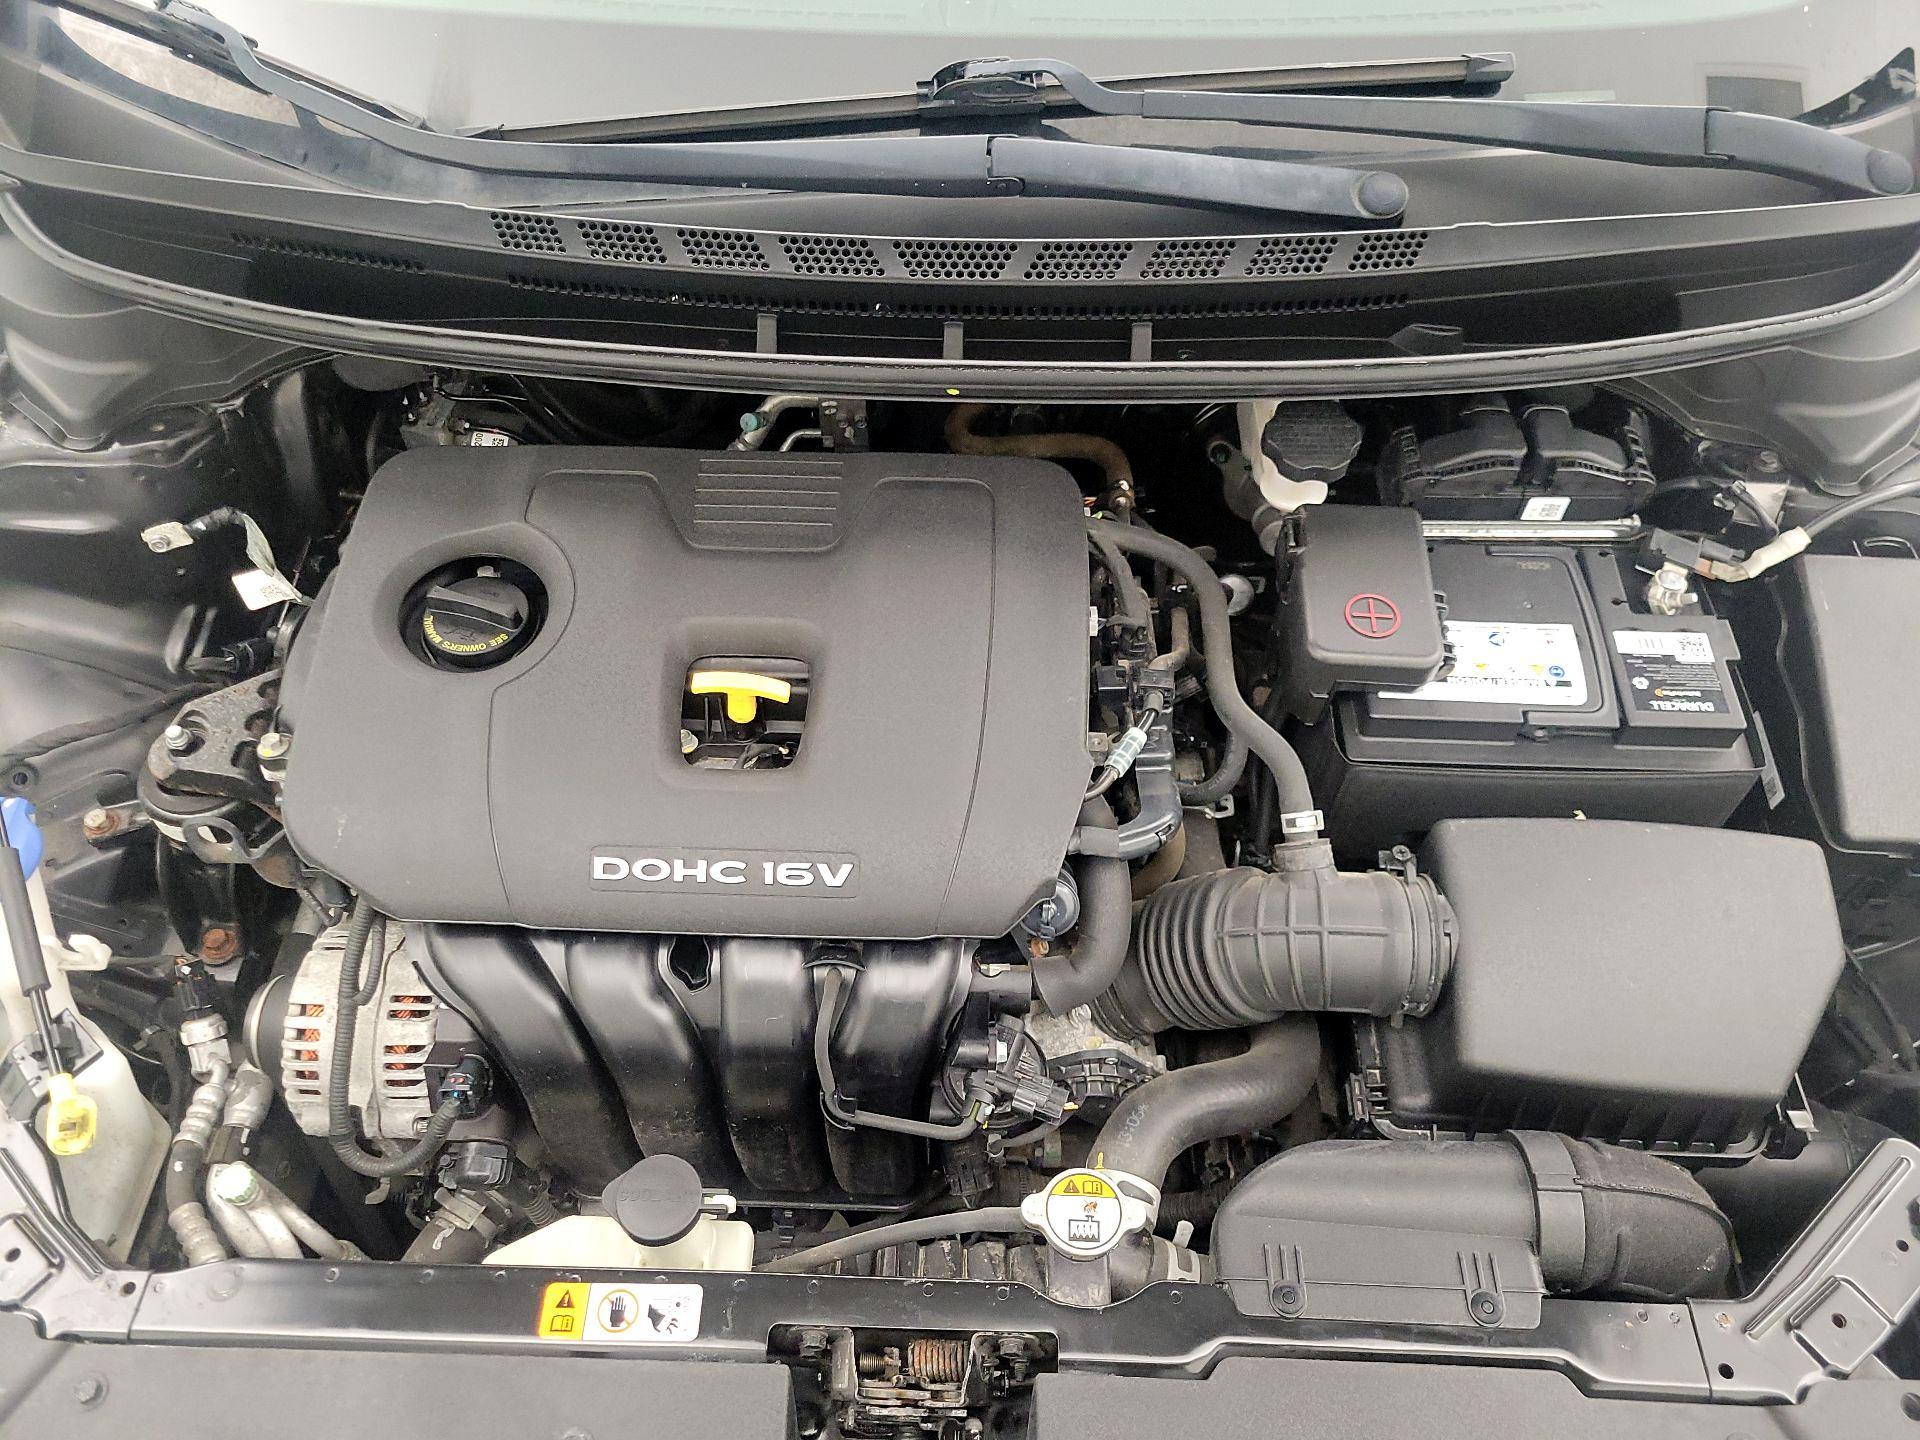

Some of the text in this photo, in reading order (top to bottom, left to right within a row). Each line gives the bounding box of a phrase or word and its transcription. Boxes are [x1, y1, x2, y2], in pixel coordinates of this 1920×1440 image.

[423, 614, 443, 644] MANUAL
[488, 633, 508, 646] SEE
[1649, 700, 1715, 712] DURACELL
[593, 856, 855, 888] DOHC 16V
